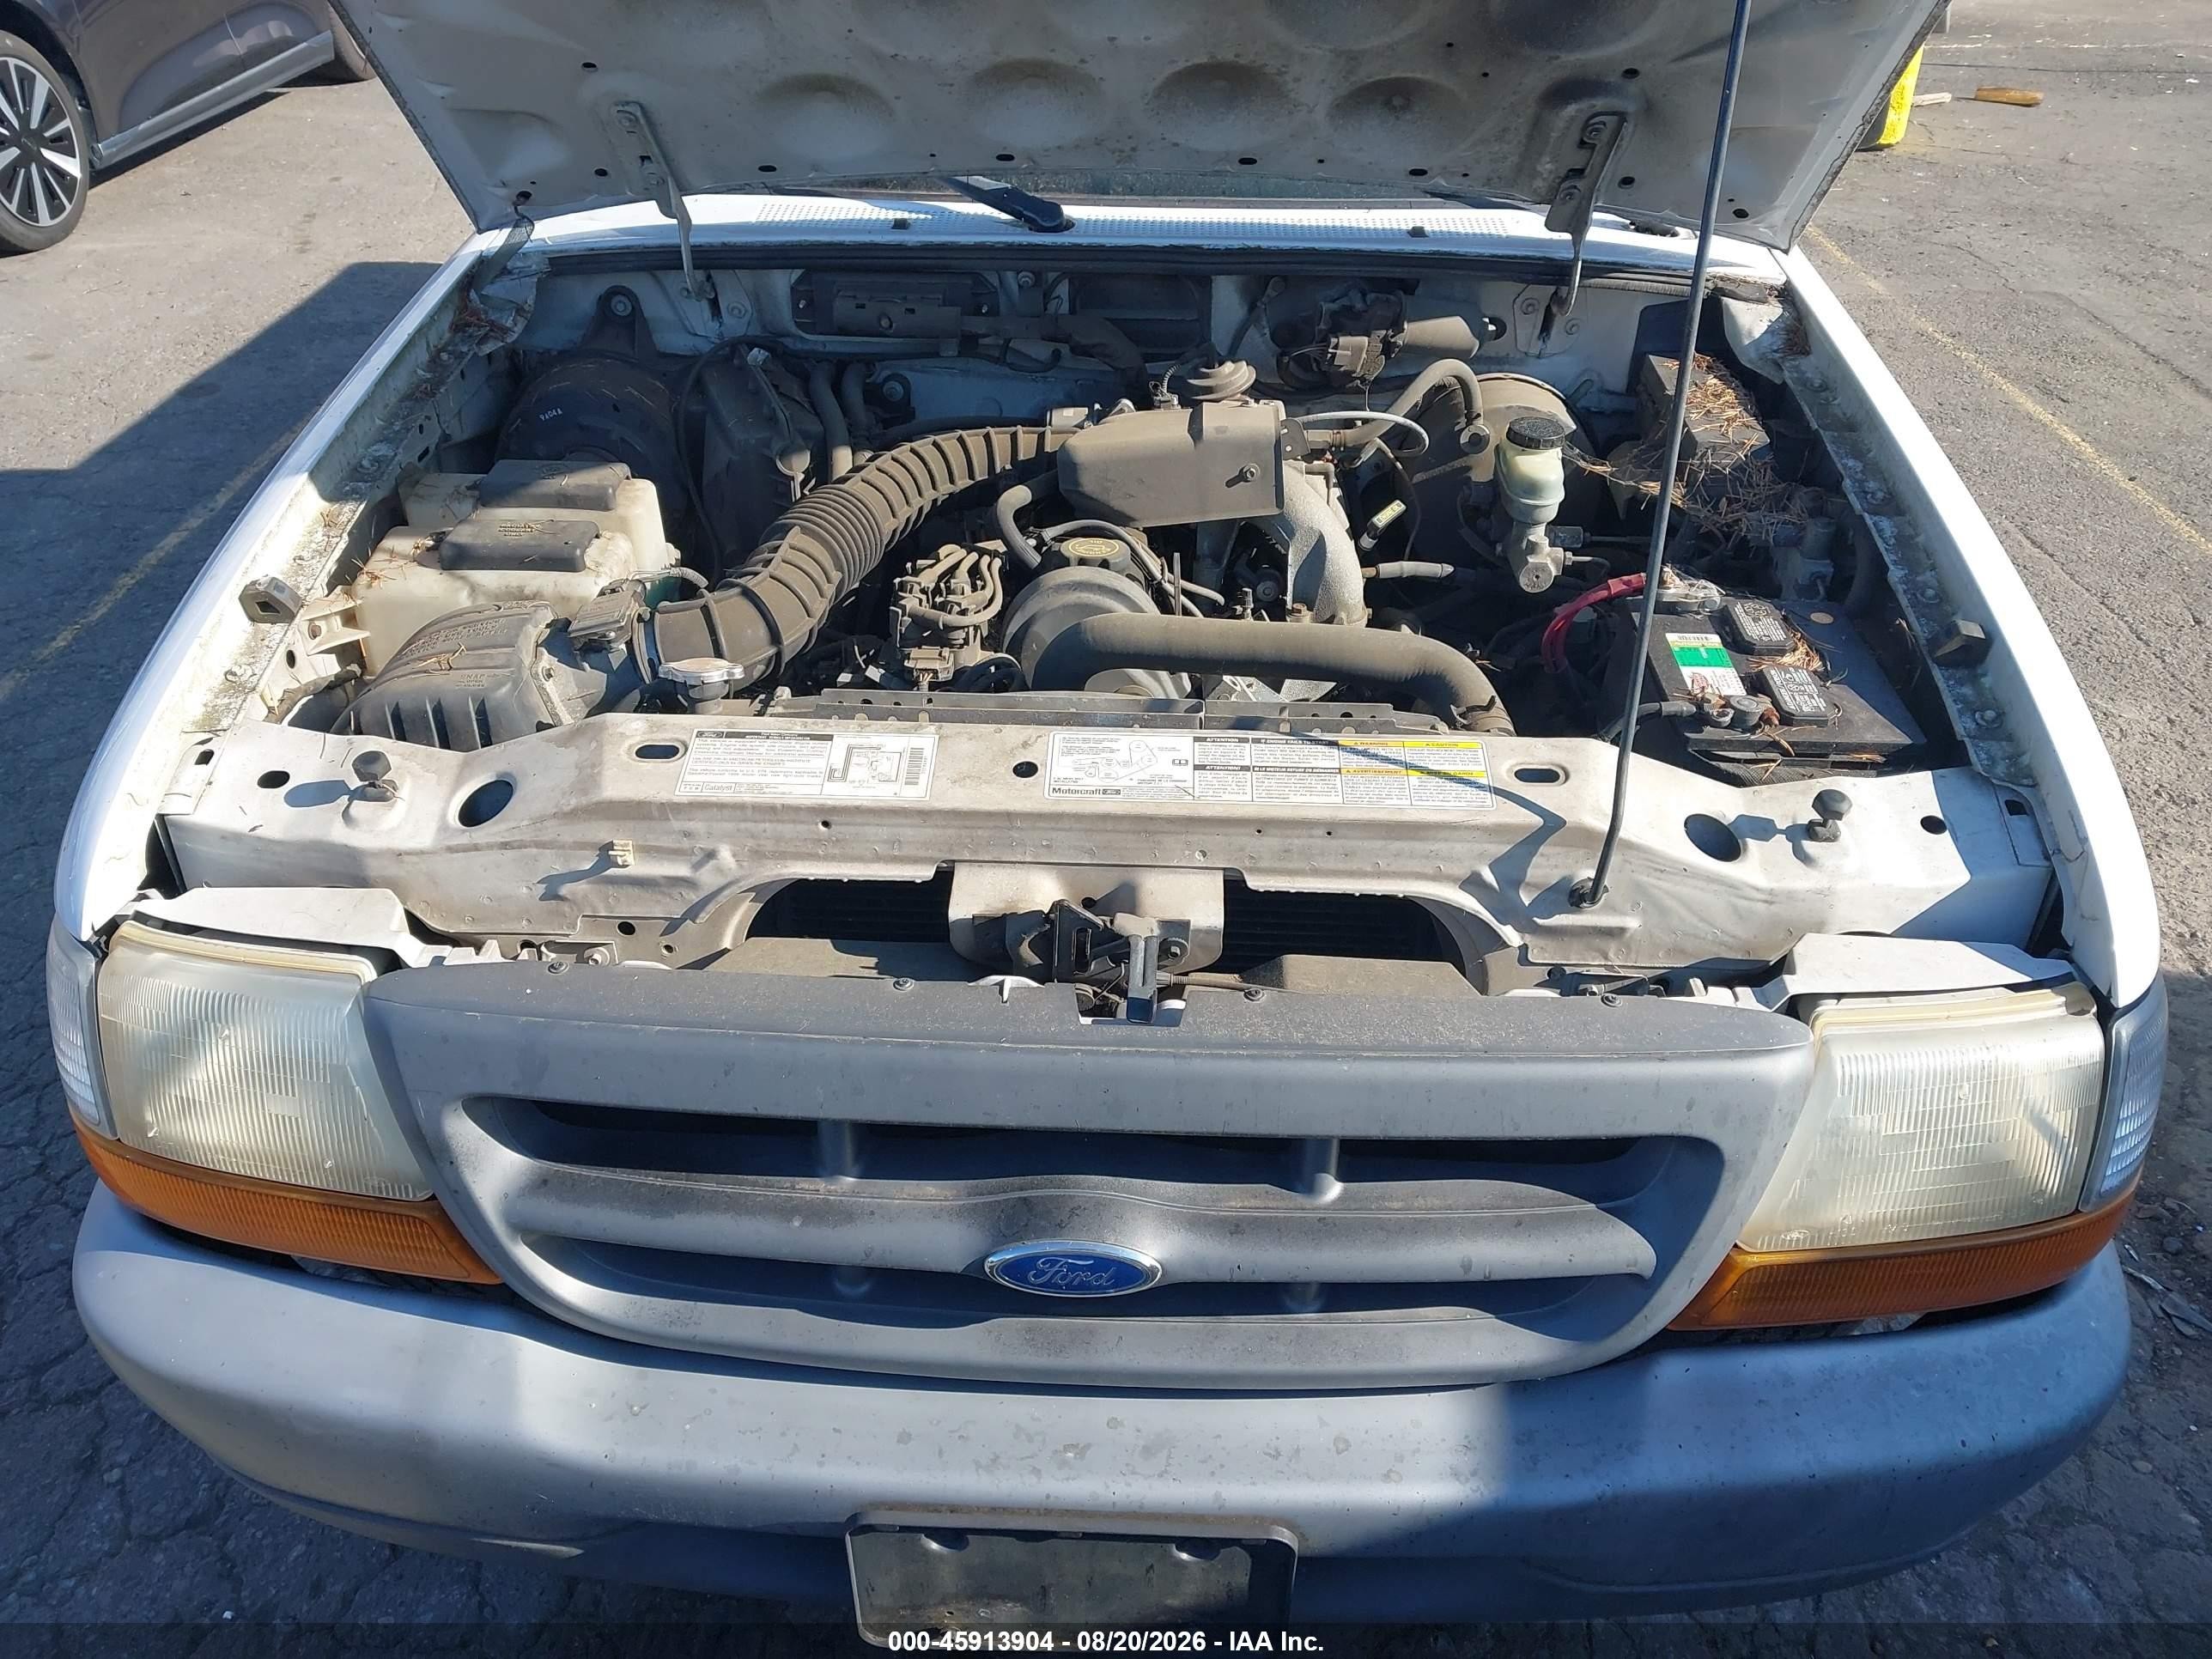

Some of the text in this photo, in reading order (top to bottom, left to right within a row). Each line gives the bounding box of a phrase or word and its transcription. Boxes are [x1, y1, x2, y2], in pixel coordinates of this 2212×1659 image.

[704, 783, 733, 792] Catalyst
[1052, 787, 1101, 795] Motorcraft
[1026, 1256, 1115, 1285] Ford
